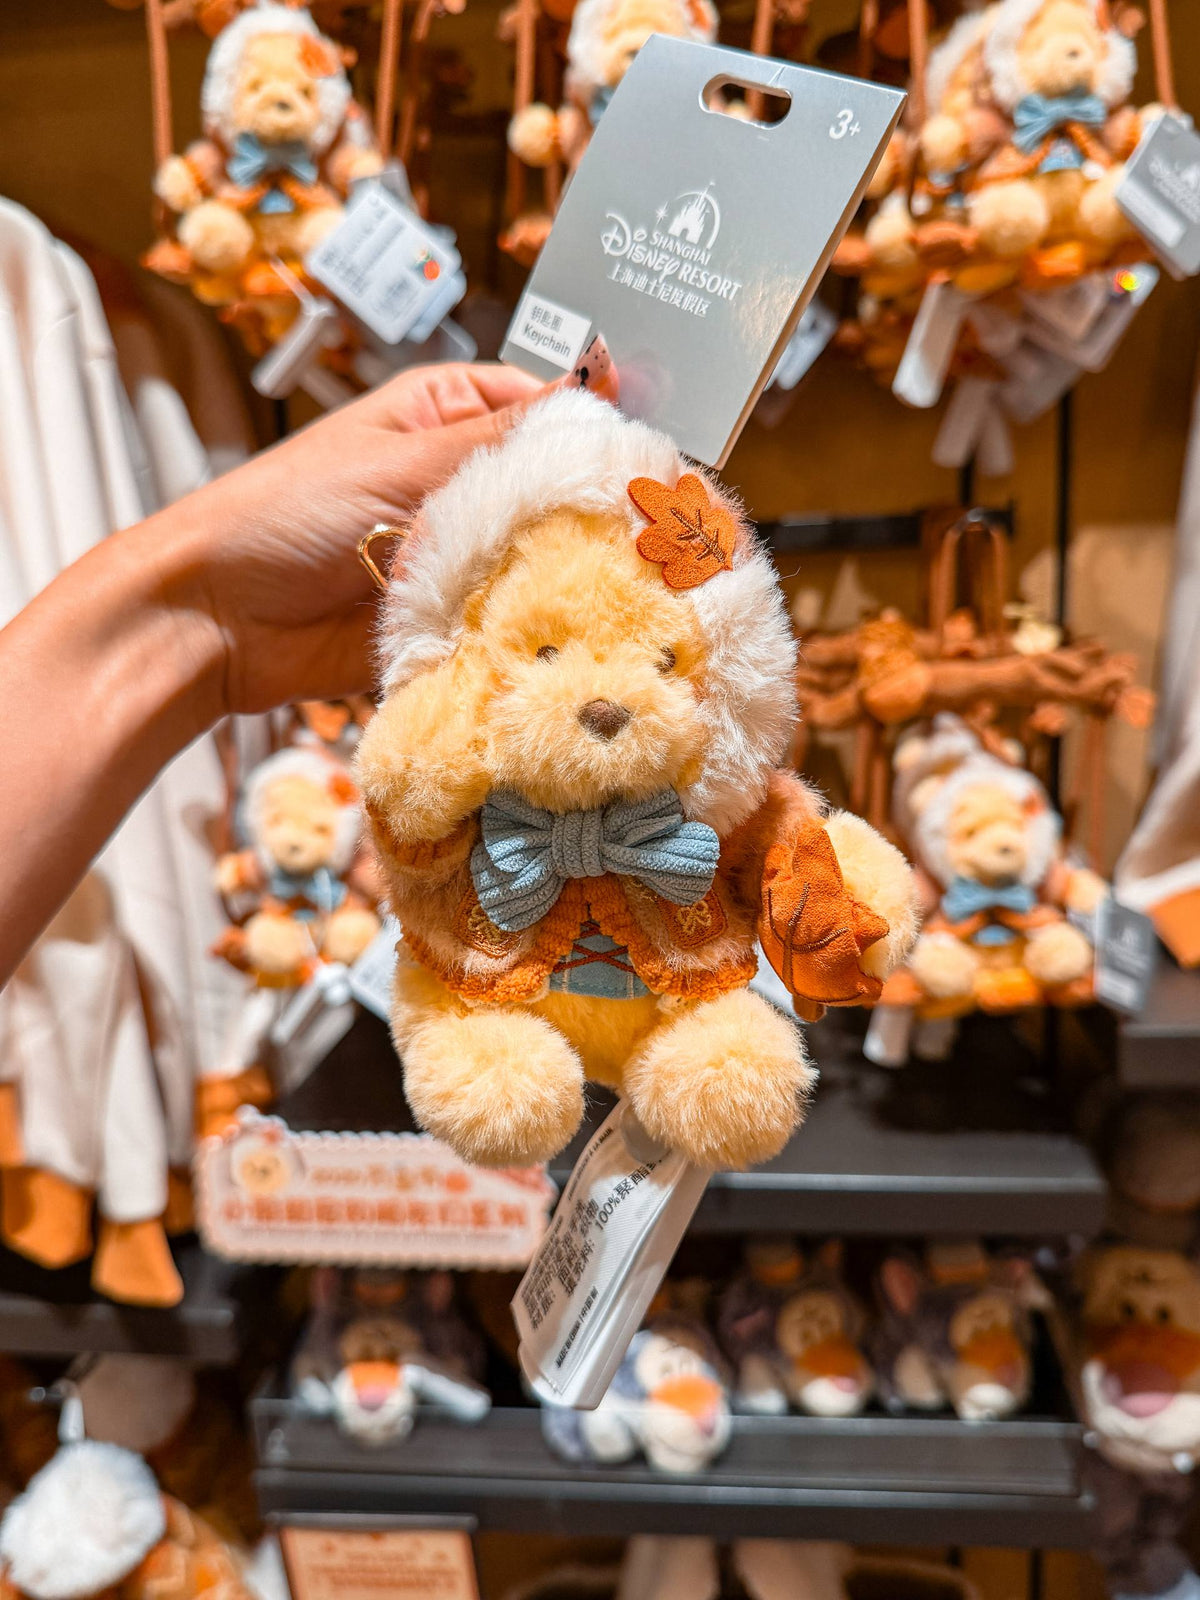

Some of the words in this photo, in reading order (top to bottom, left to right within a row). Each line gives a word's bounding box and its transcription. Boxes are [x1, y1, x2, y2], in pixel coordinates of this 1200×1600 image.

[829, 109, 861, 139] 3+
[649, 230, 712, 266] SHANGHAI
[606, 263, 712, 318] 上海迪士尼度假区
[678, 262, 742, 301] RESORT
[523, 323, 571, 358] Keychain
